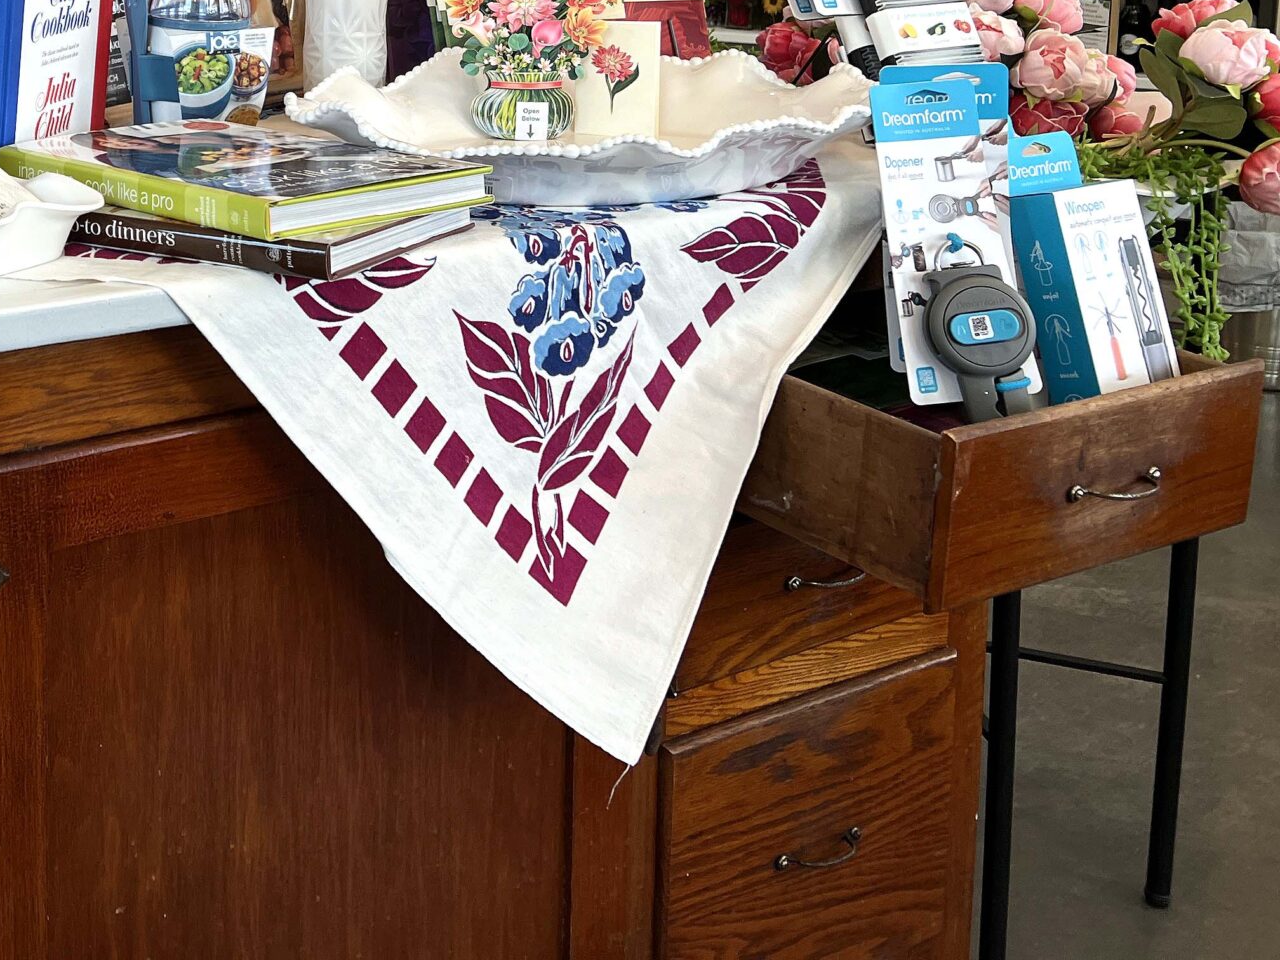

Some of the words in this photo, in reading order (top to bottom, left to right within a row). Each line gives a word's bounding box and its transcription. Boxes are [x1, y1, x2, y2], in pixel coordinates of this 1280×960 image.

[30, 0, 93, 43] Cookbook
[209, 32, 239, 54] joie
[35, 71, 77, 113] Julia
[34, 102, 73, 140] Child
[522, 107, 540, 115] Open
[881, 109, 965, 127] Dreamfarm
[884, 156, 924, 171] Dopener
[1009, 159, 1072, 180] Dreamfarm
[117, 181, 138, 203] like
[140, 194, 148, 205] a
[151, 193, 174, 211] pro
[1064, 200, 1106, 216] Winopen
[105, 219, 176, 247] dinners
